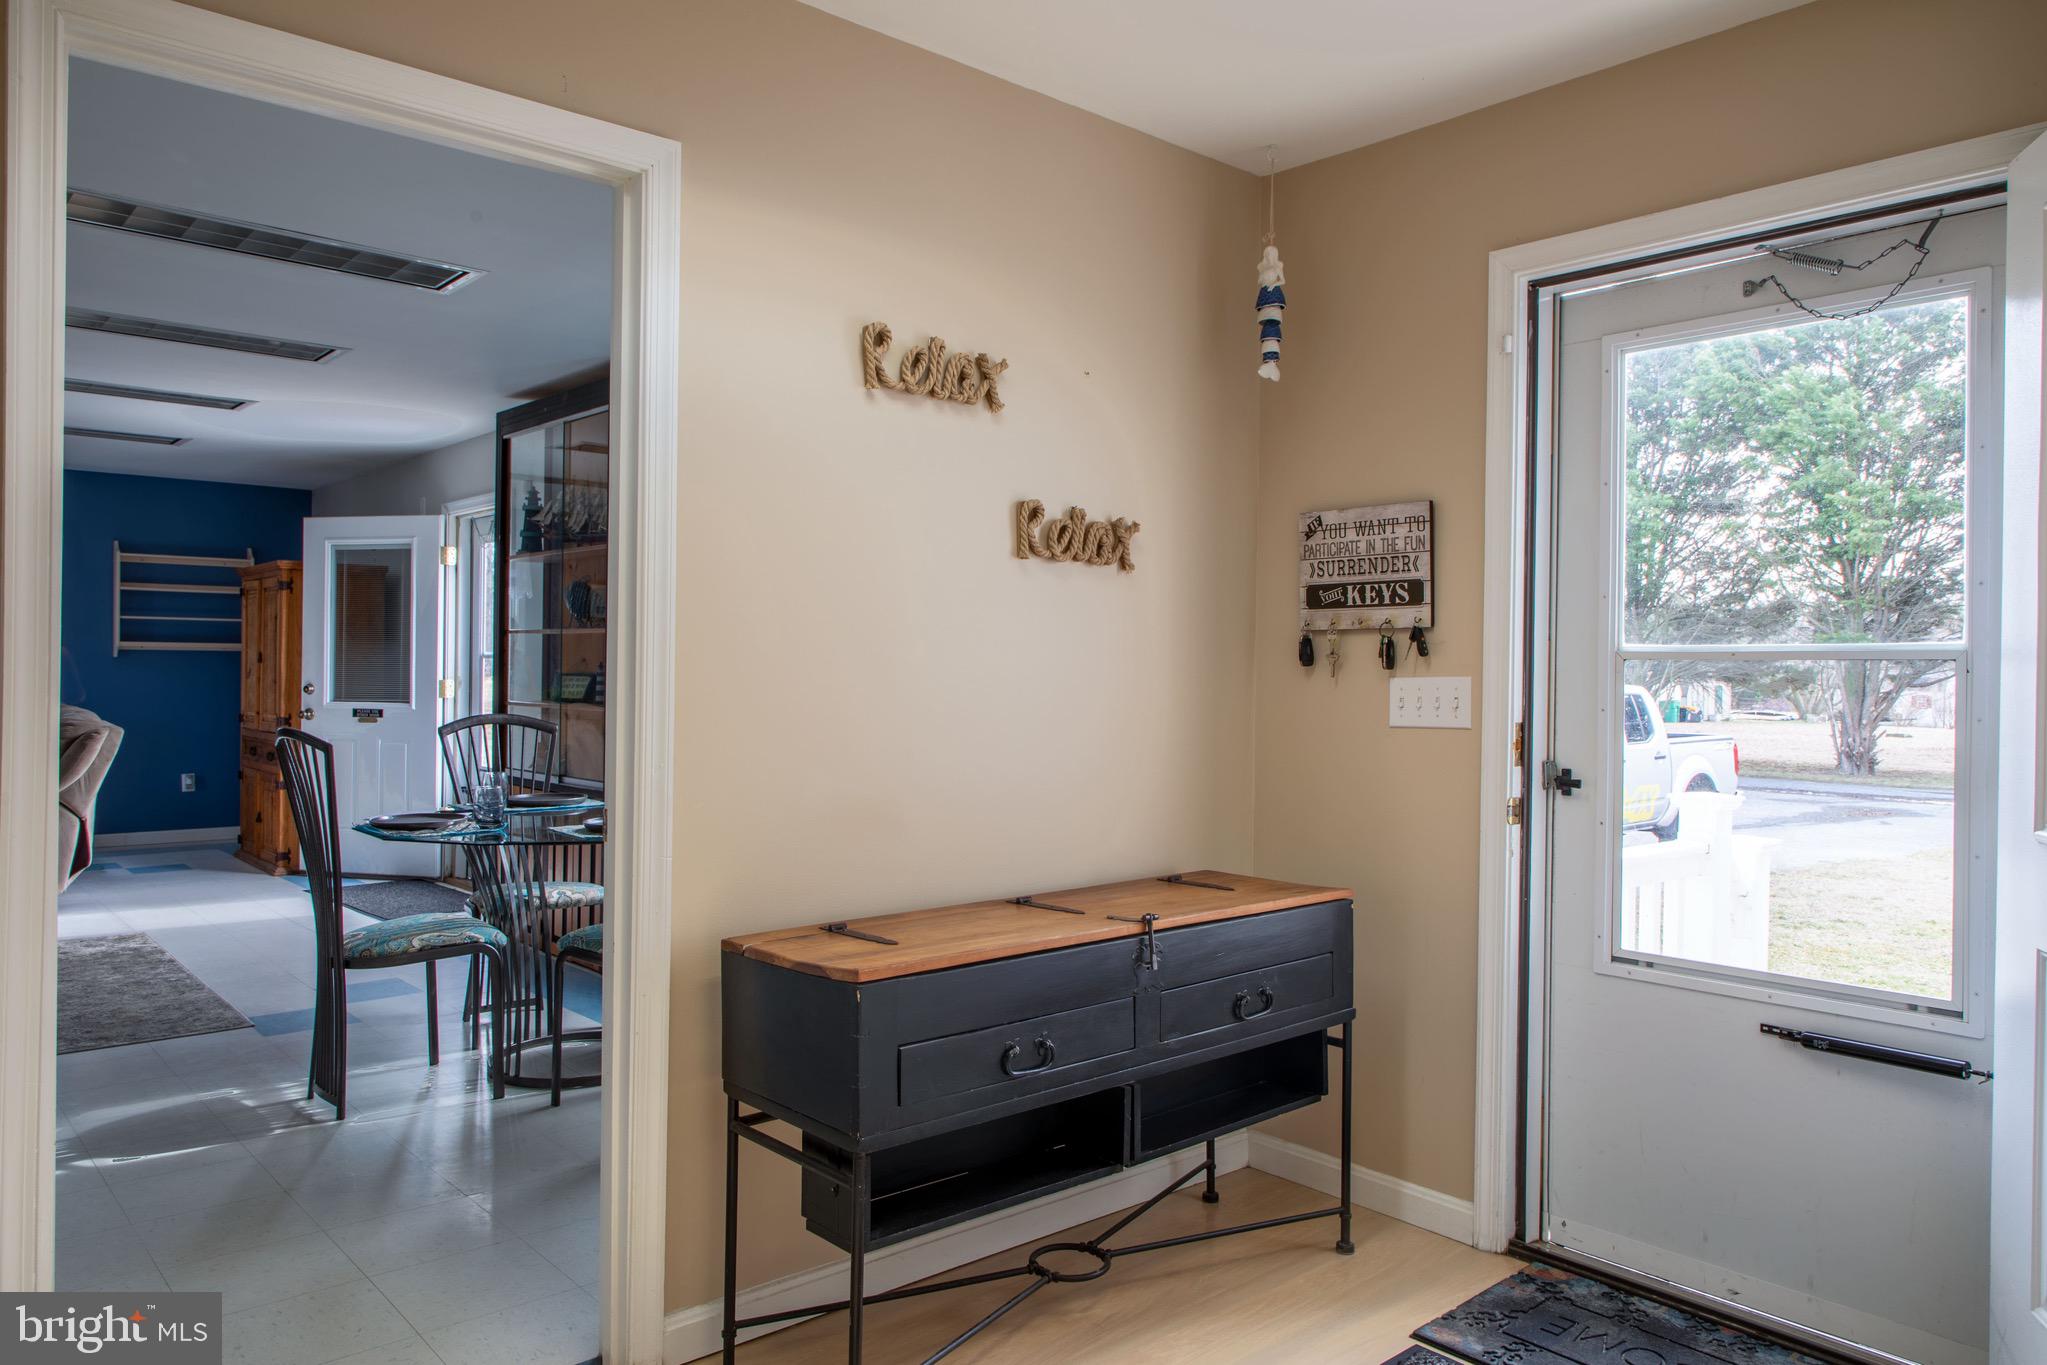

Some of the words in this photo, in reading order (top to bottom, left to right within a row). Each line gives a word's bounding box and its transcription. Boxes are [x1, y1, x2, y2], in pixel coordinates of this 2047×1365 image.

[862, 321, 1009, 414] Relax
[1016, 499, 1141, 573] Relax
[1320, 522, 1347, 540] YOU
[1352, 517, 1399, 537] WANT
[1404, 515, 1426, 533] TO
[1303, 540, 1362, 558] PARTICIPATE
[1366, 539, 1376, 554] IN
[1381, 537, 1399, 553] THE
[1404, 535, 1426, 551] FUN
[1316, 554, 1412, 578] SURRENDER
[1346, 582, 1410, 606] KEYS
